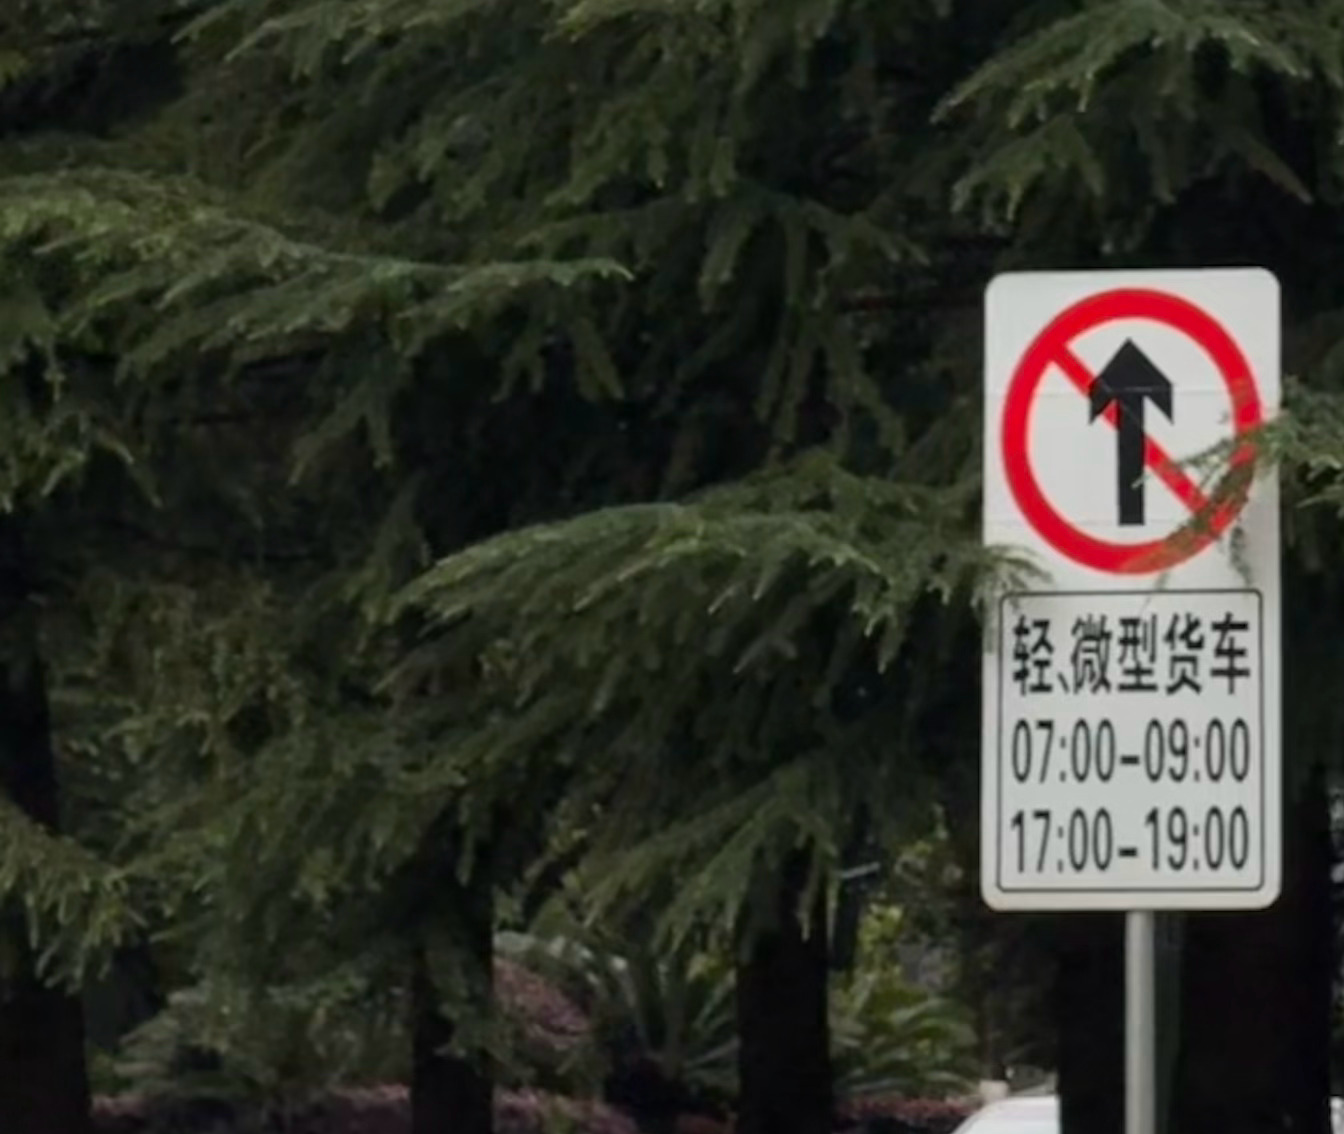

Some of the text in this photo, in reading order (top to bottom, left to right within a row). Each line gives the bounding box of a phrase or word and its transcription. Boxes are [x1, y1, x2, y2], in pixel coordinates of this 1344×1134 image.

[1013, 613, 1251, 695] 轻、微型货车
[1012, 718, 1251, 783] 07:00-09:00
[1010, 806, 1250, 873] 17:00-19:00
